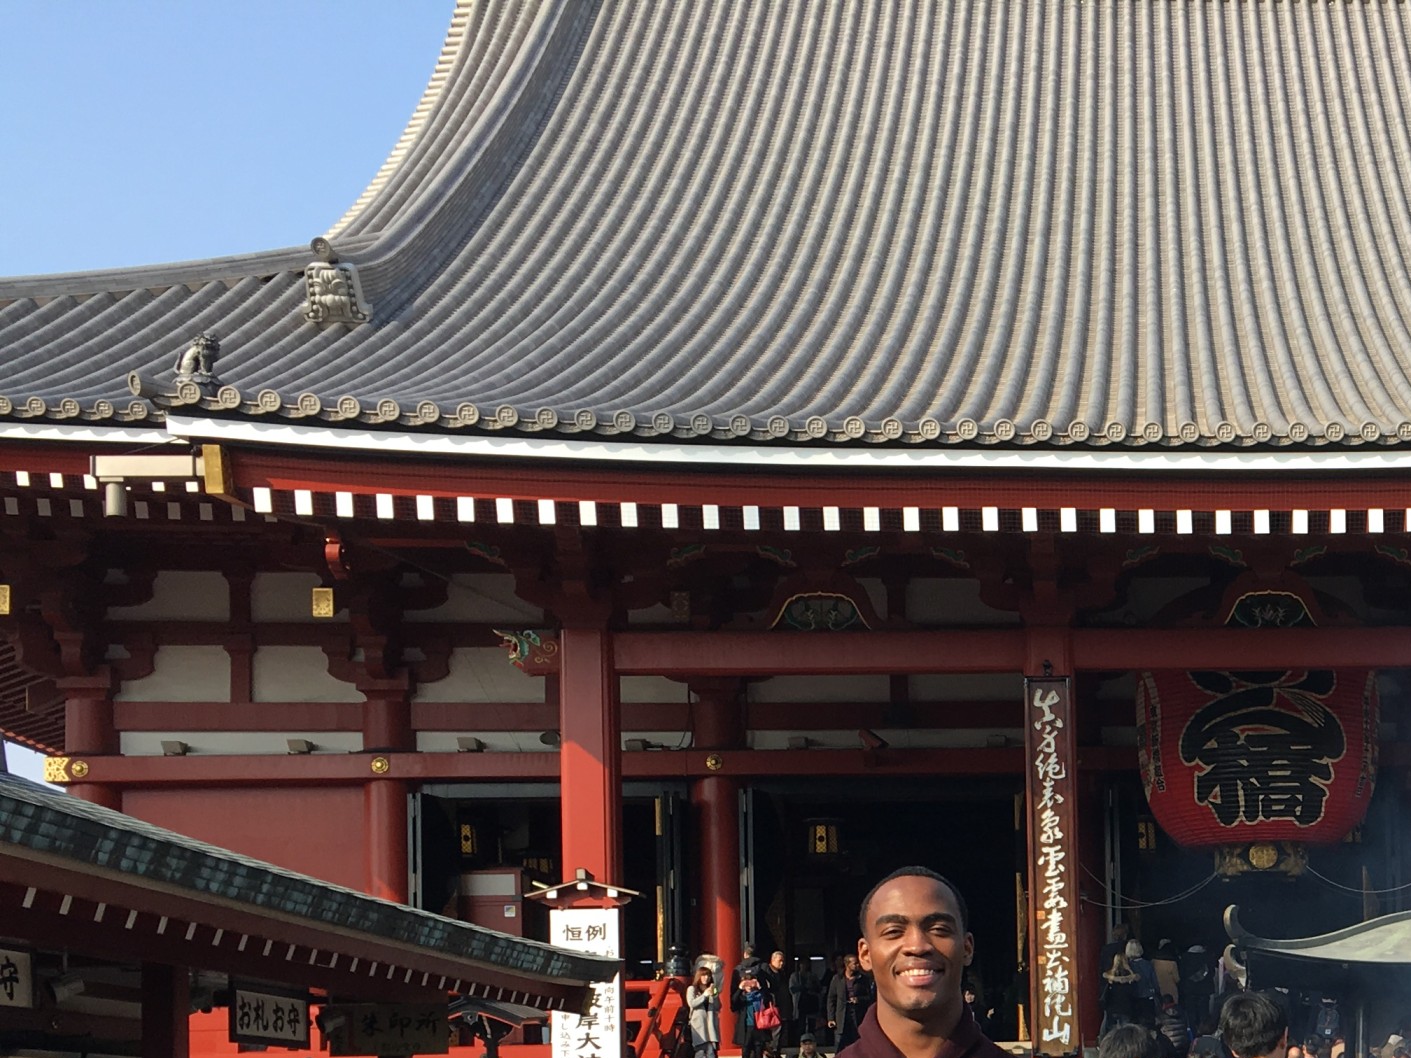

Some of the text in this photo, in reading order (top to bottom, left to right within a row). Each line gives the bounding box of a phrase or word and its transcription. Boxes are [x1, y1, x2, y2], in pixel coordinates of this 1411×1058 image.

[562, 923, 607, 942] 恒例
[237, 996, 301, 1037] お札お守
